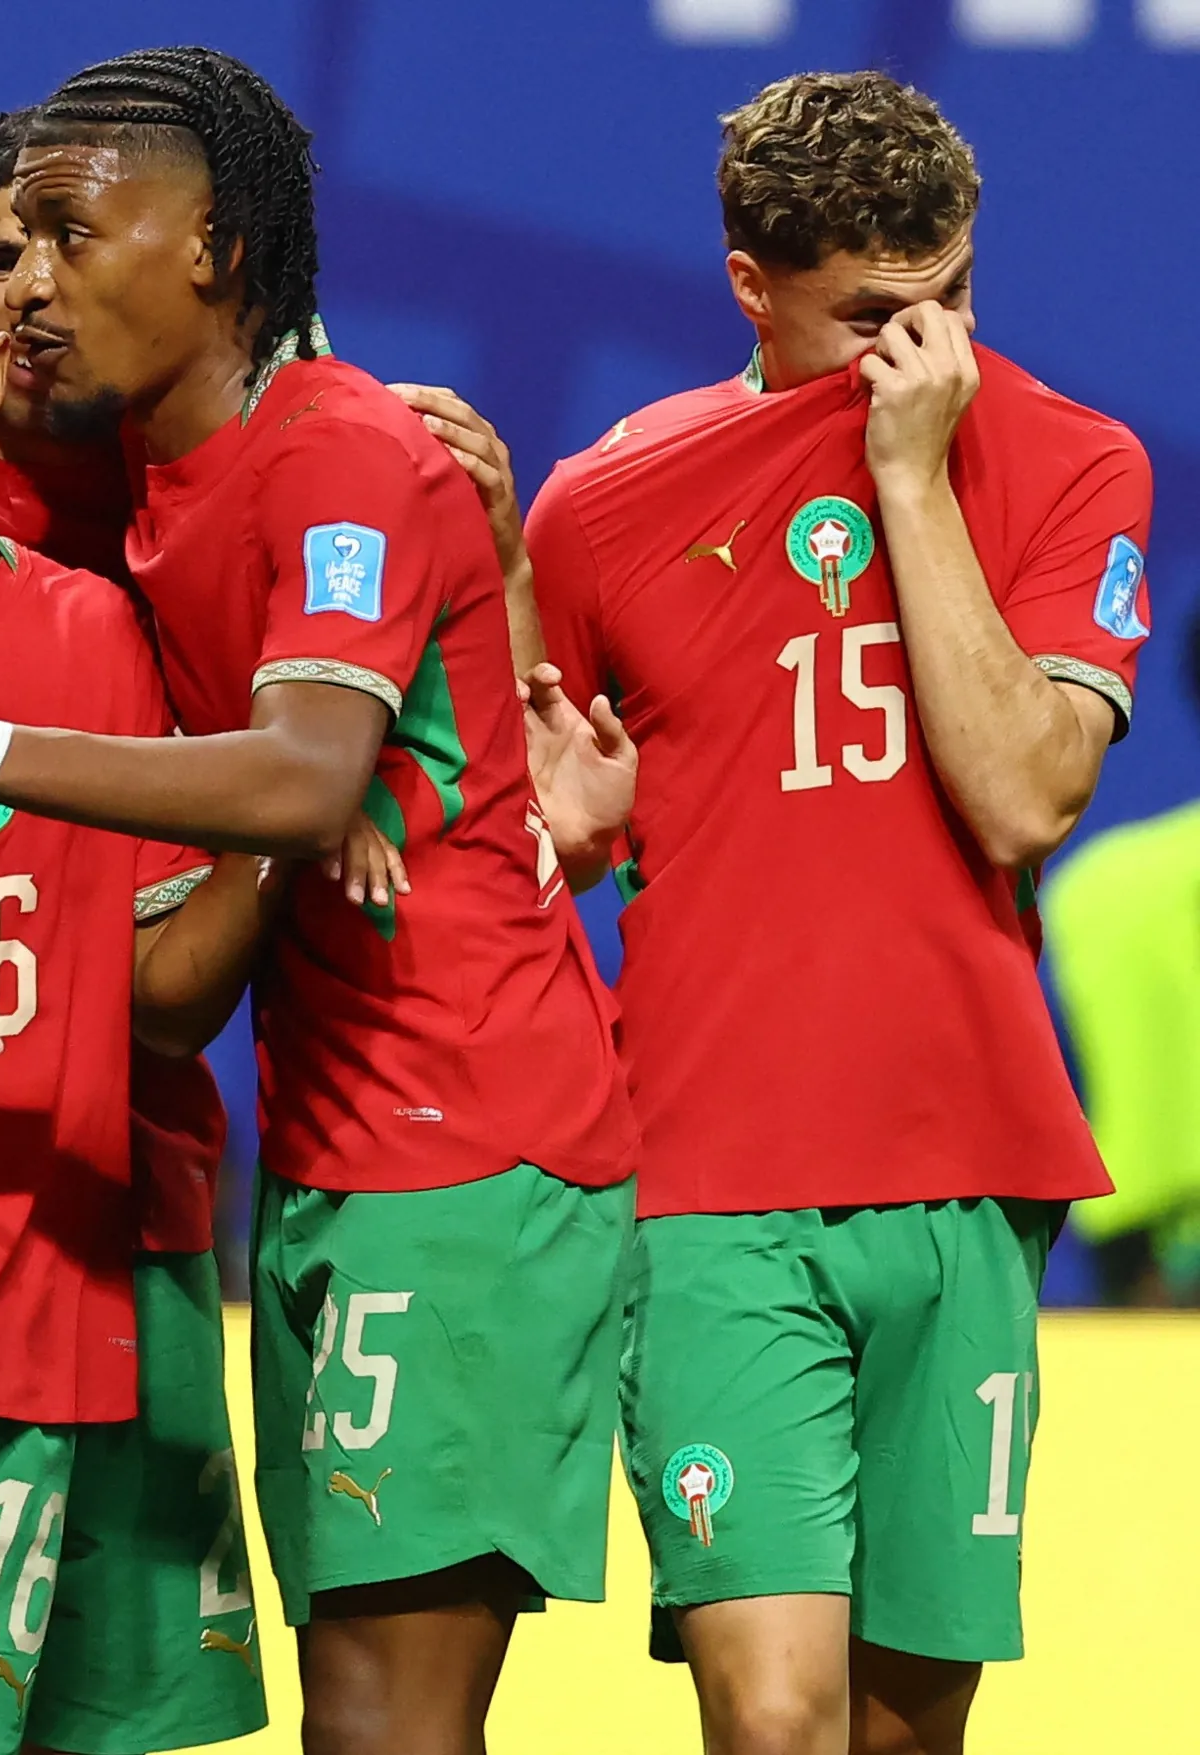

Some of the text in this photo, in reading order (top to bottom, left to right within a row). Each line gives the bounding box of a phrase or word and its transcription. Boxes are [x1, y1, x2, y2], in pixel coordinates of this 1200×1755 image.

[328, 575, 362, 598] PEACE
[776, 622, 907, 792] 15
[971, 1372, 1034, 1536] 1
